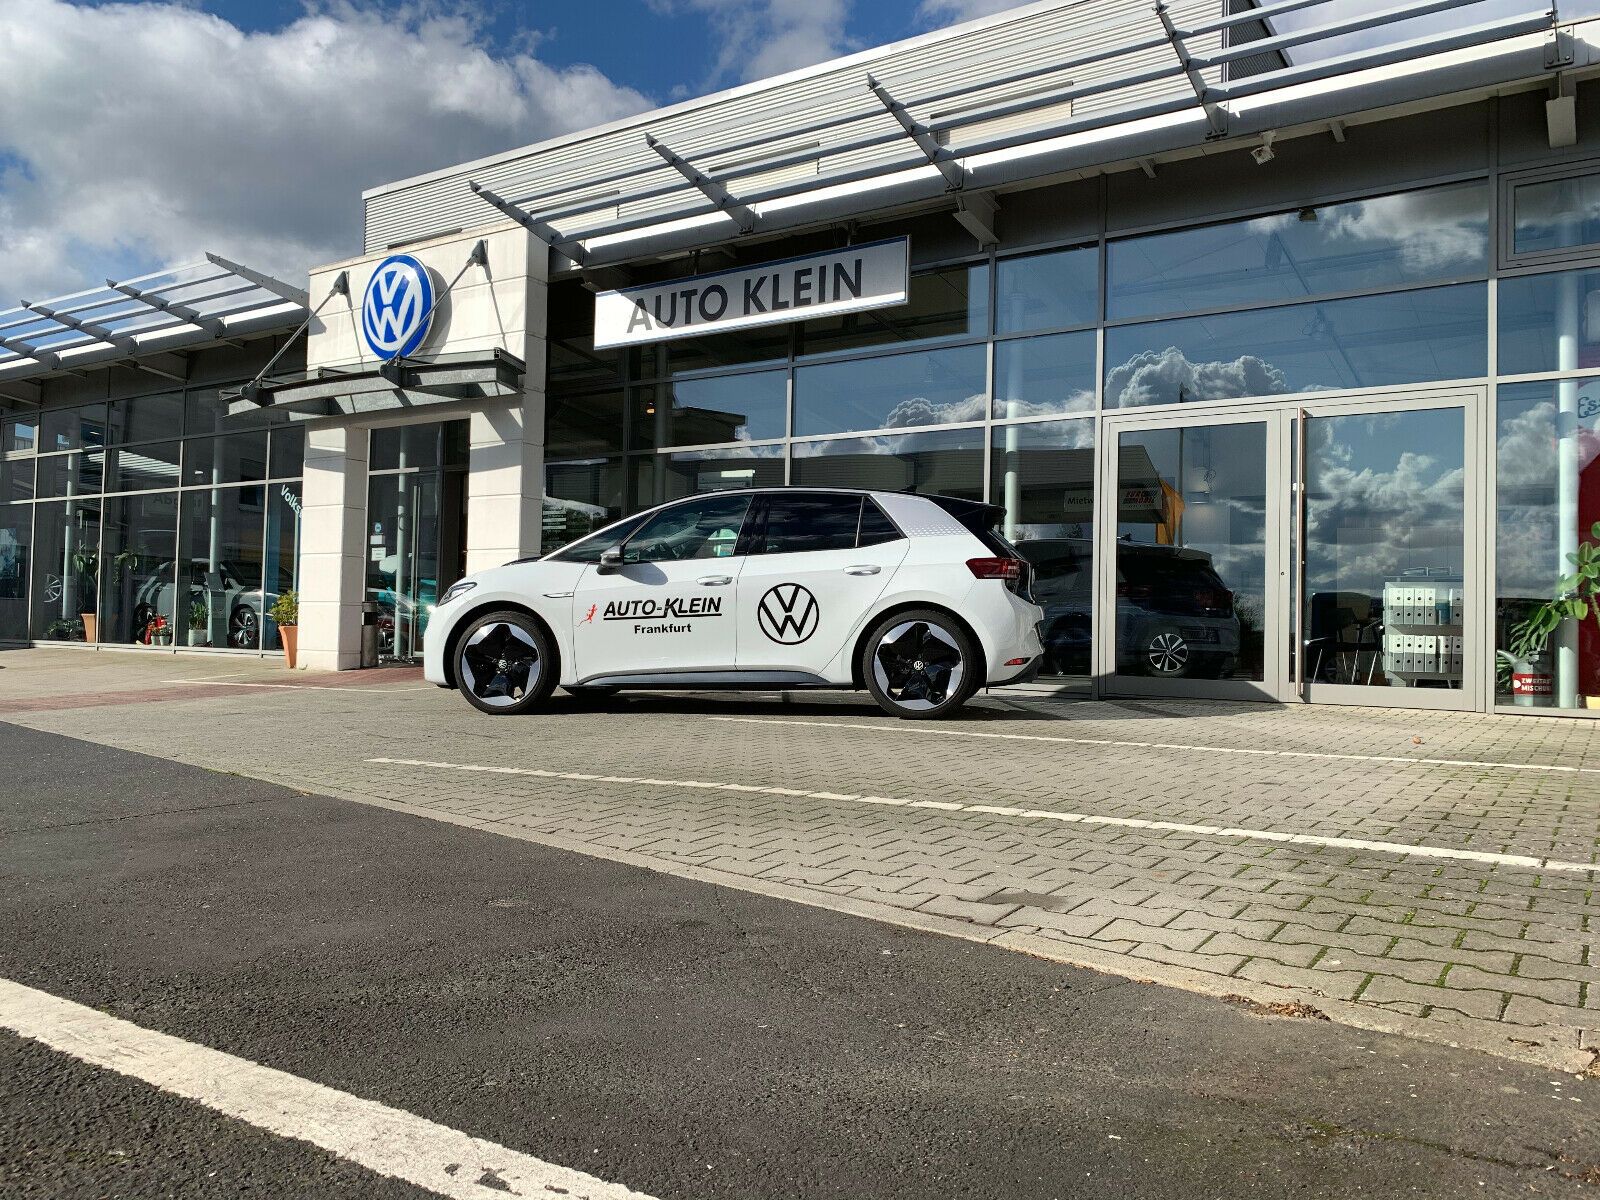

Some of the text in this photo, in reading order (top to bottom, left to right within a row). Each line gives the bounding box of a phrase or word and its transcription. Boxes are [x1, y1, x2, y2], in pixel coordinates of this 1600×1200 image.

[364, 261, 424, 352] VW
[626, 258, 863, 334] AUTO KLEIN
[281, 484, 302, 518] Volks
[603, 597, 722, 618] AUTO-KLEIN
[633, 623, 692, 635] Frankfurt
[758, 583, 819, 644] VW
